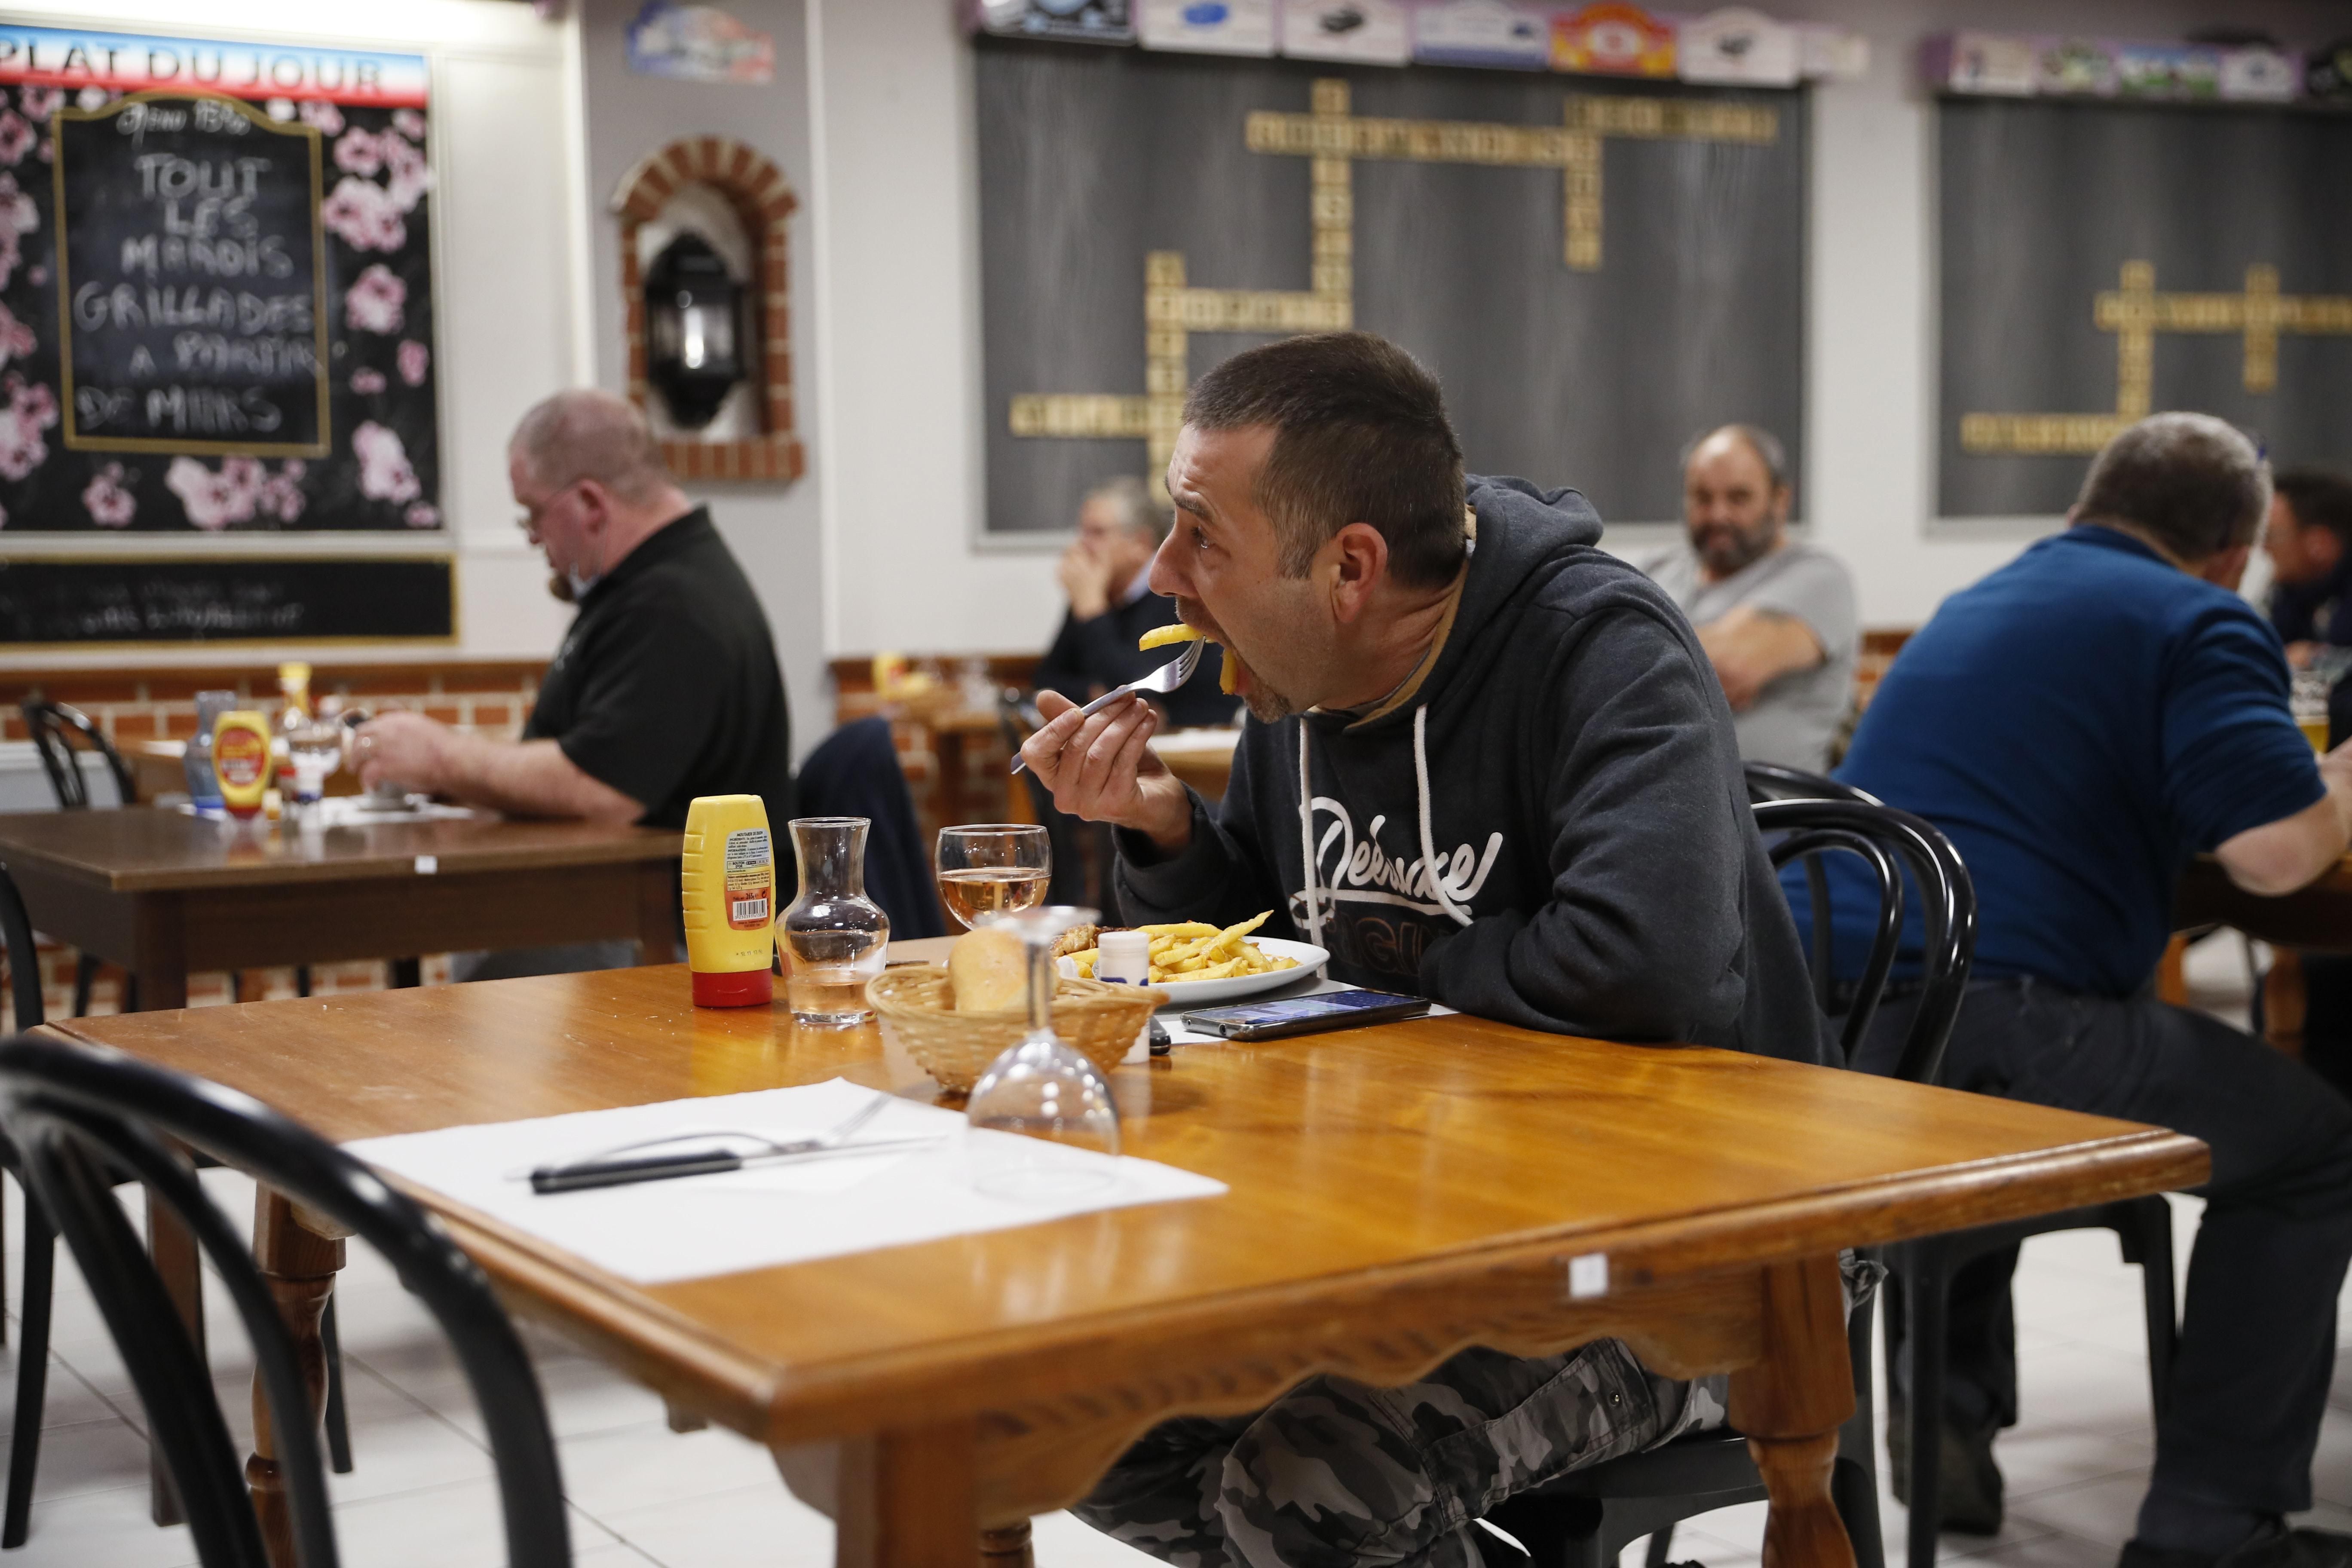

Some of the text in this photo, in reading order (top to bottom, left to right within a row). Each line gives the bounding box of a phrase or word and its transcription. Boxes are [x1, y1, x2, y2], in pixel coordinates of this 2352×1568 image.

[149, 48, 223, 83] DU
[246, 53, 381, 92] JOUR
[134, 153, 273, 201] TOUT
[164, 196, 257, 240] LES
